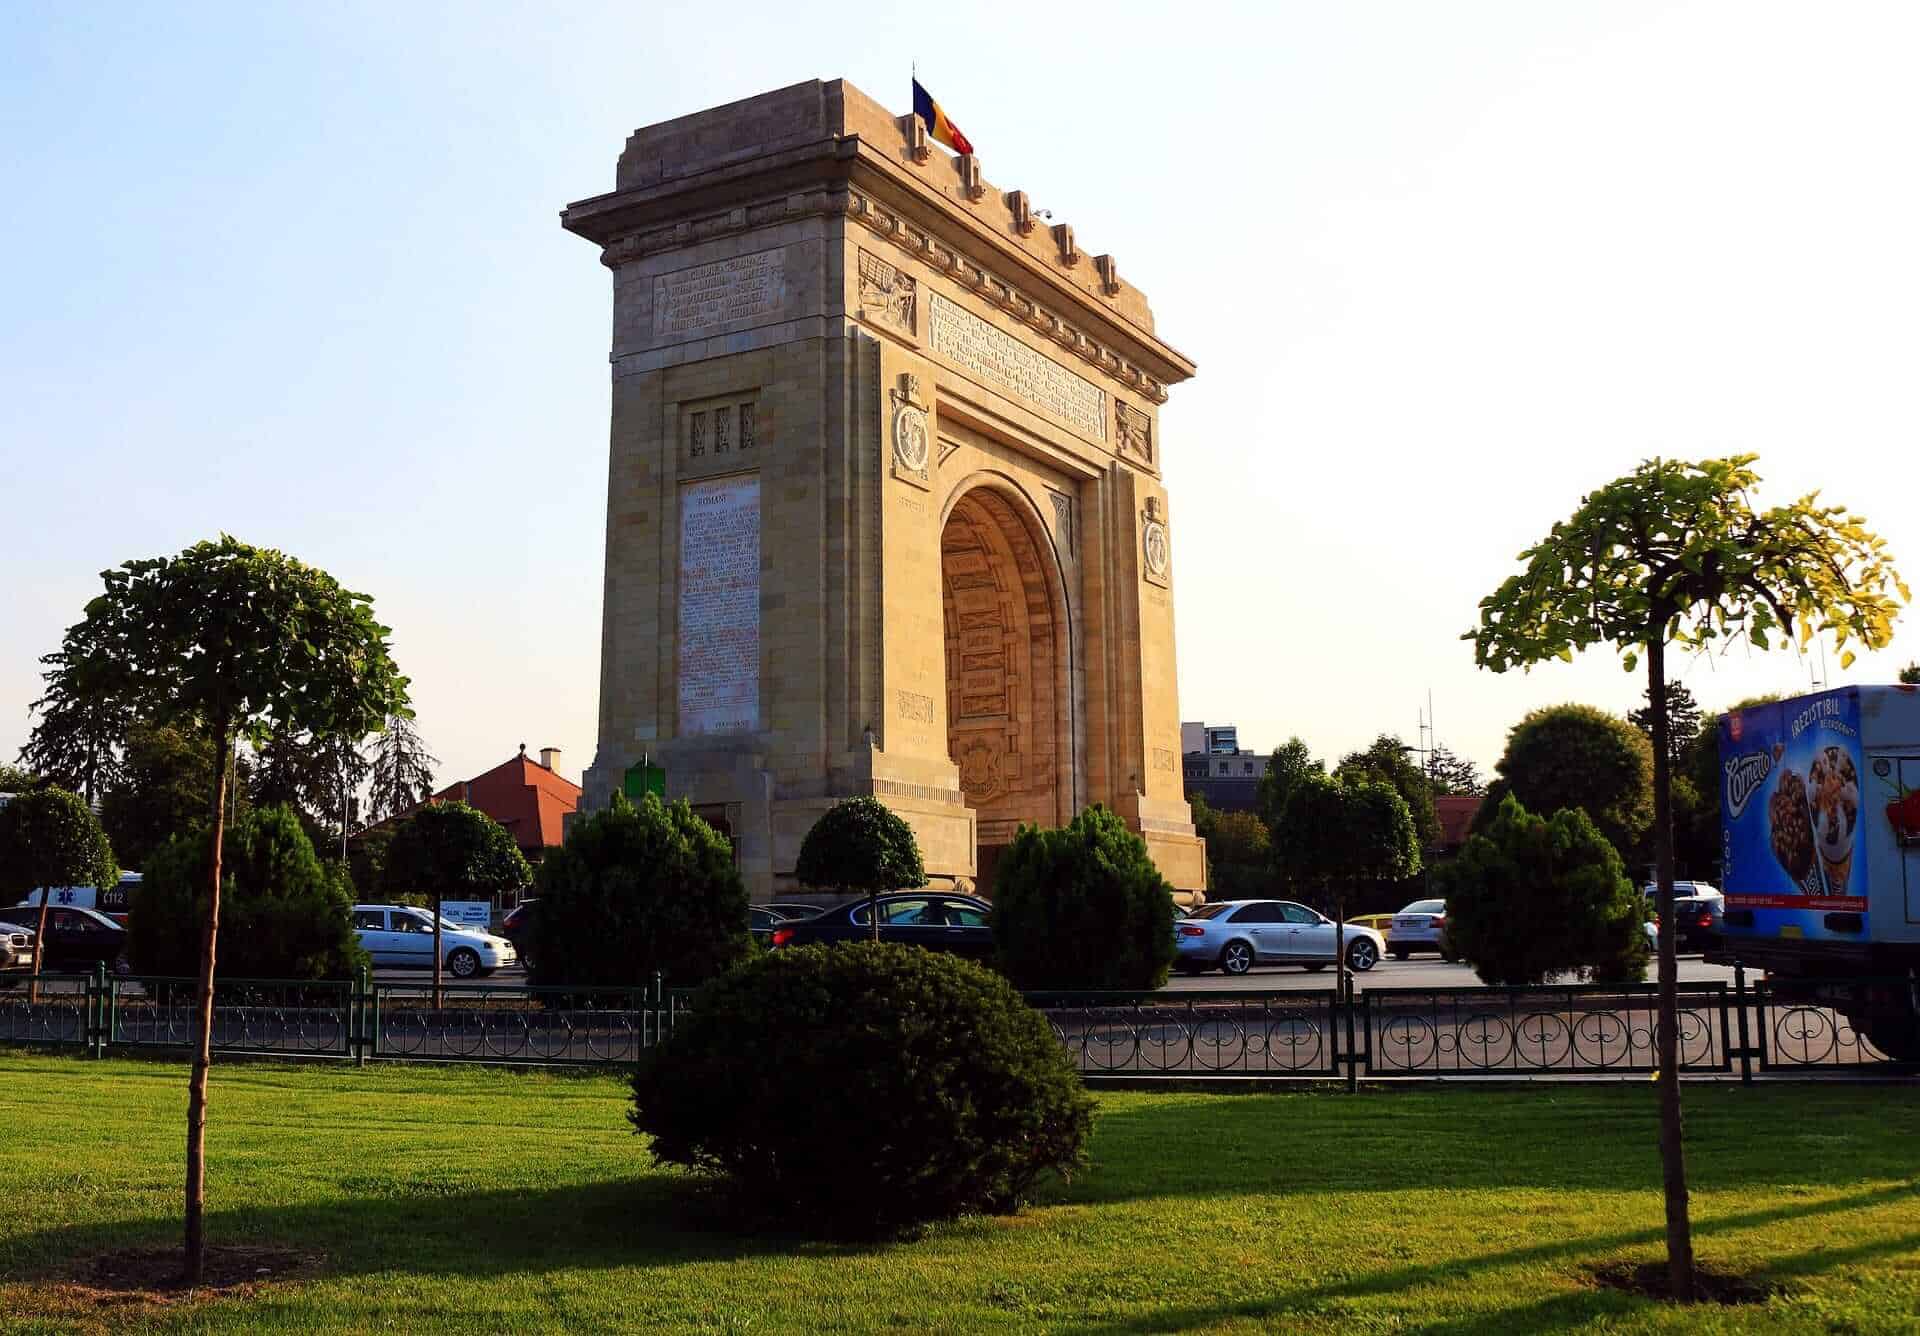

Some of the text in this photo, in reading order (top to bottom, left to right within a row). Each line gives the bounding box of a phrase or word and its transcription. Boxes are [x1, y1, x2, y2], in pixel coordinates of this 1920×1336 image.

[1791, 697, 1840, 738] IREZISTIBIL
[1725, 751, 1770, 818] Cornetto
[109, 893, 124, 904] 112
